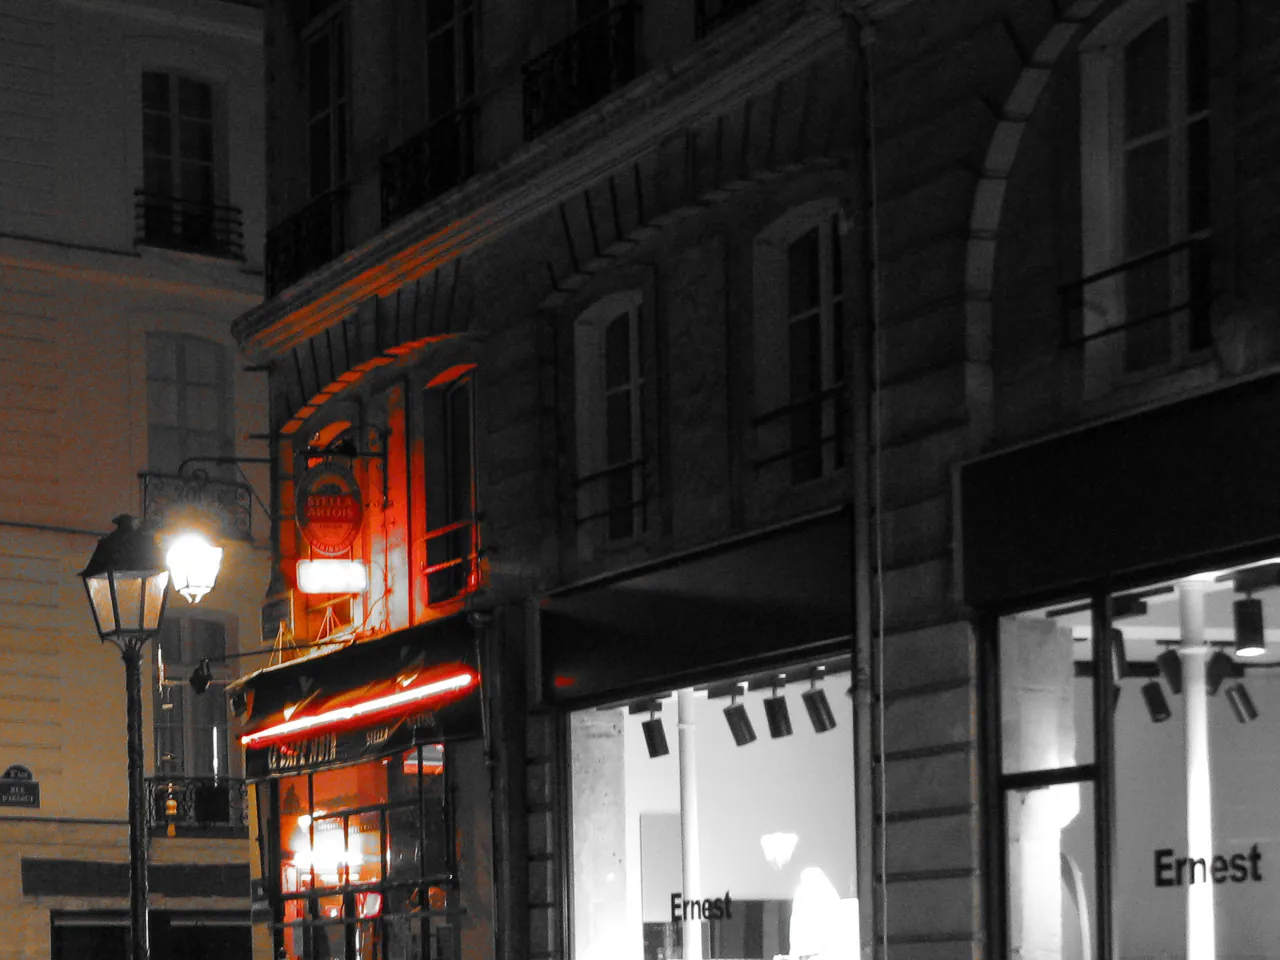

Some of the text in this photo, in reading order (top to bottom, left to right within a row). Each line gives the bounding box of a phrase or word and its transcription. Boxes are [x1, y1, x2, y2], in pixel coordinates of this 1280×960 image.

[307, 496, 353, 506] STELLA
[307, 507, 354, 517] ARTOIS
[366, 727, 389, 745] STELLA
[1153, 842, 1263, 888] Ernest
[670, 889, 733, 922] Ernest
